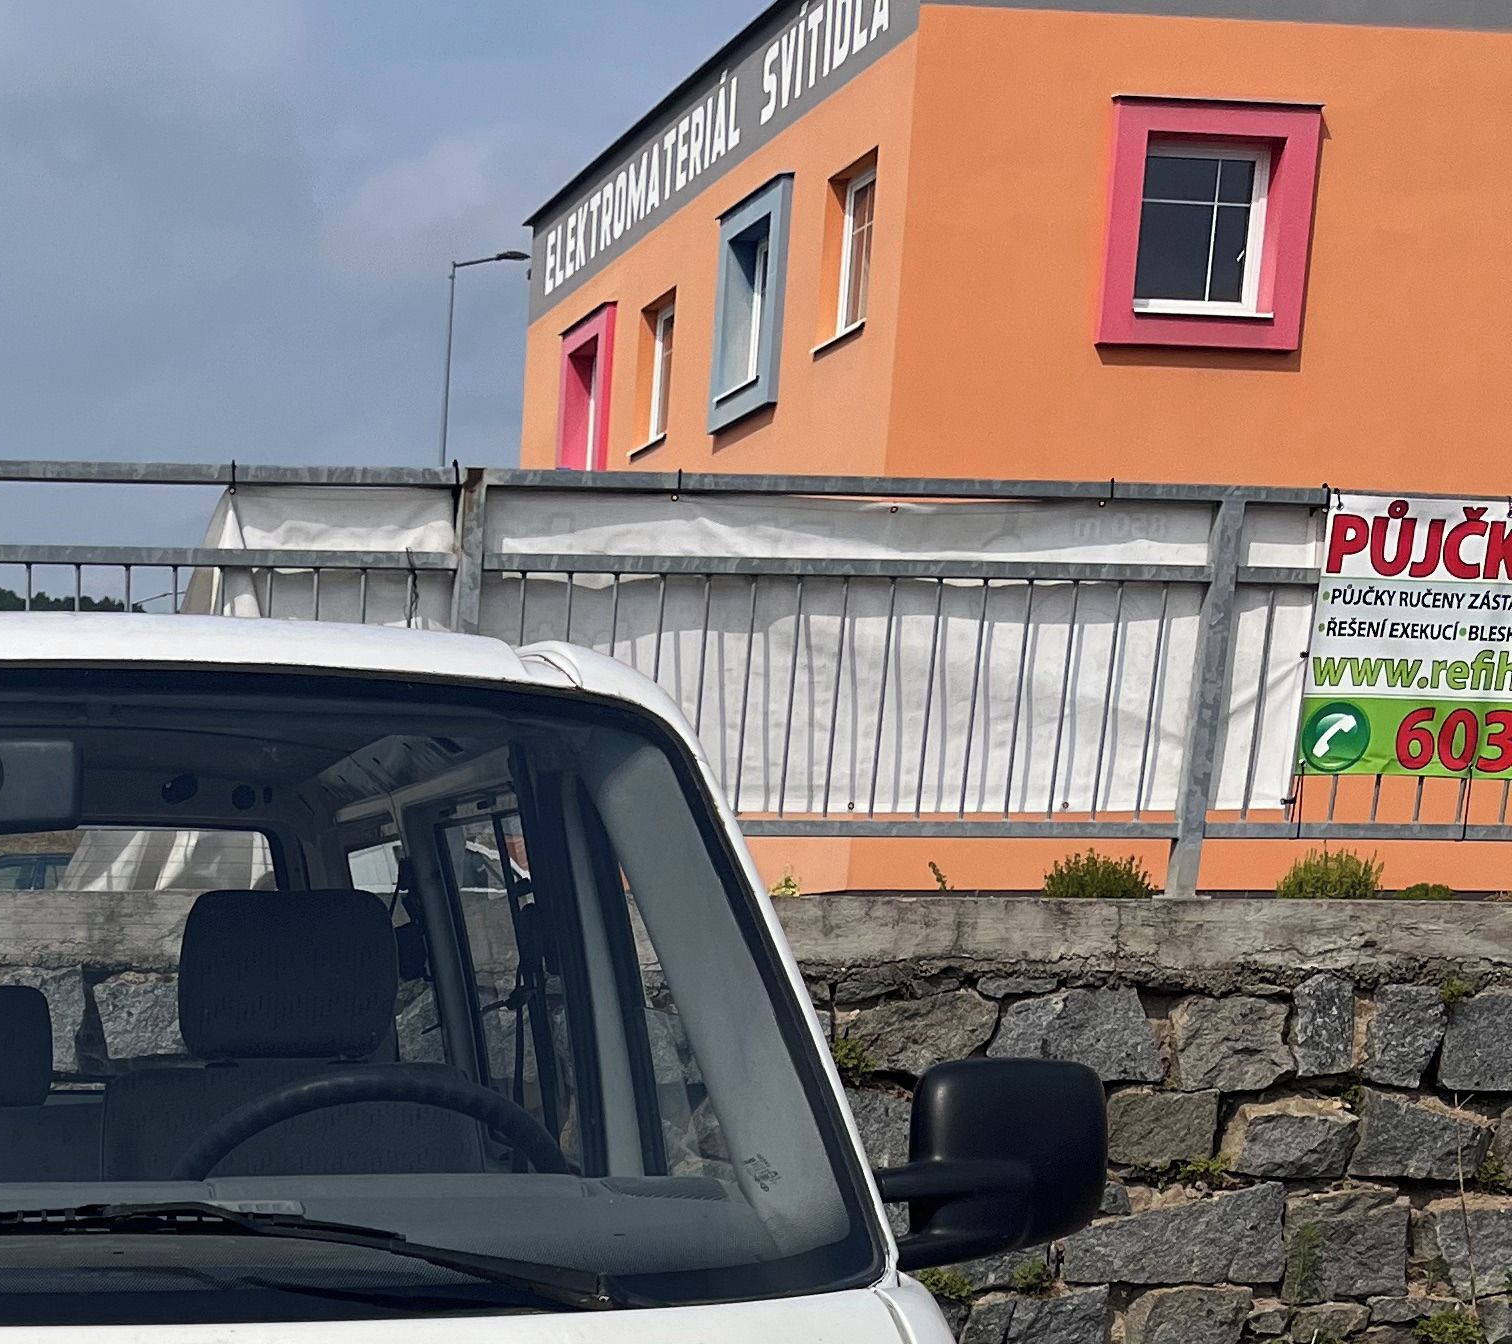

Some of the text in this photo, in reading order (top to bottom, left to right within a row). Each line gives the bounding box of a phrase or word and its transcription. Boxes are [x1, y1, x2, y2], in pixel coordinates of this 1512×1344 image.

[544, 69, 741, 296] ELEKTROMATERIÁL
[1330, 584, 1396, 607] PŮJČKY
[1399, 588, 1466, 610] RUČENY
[1325, 617, 1388, 638] ŘEŠENÍ
[1389, 621, 1460, 641] EXEKUCÍ
[1395, 707, 1512, 773] 603
